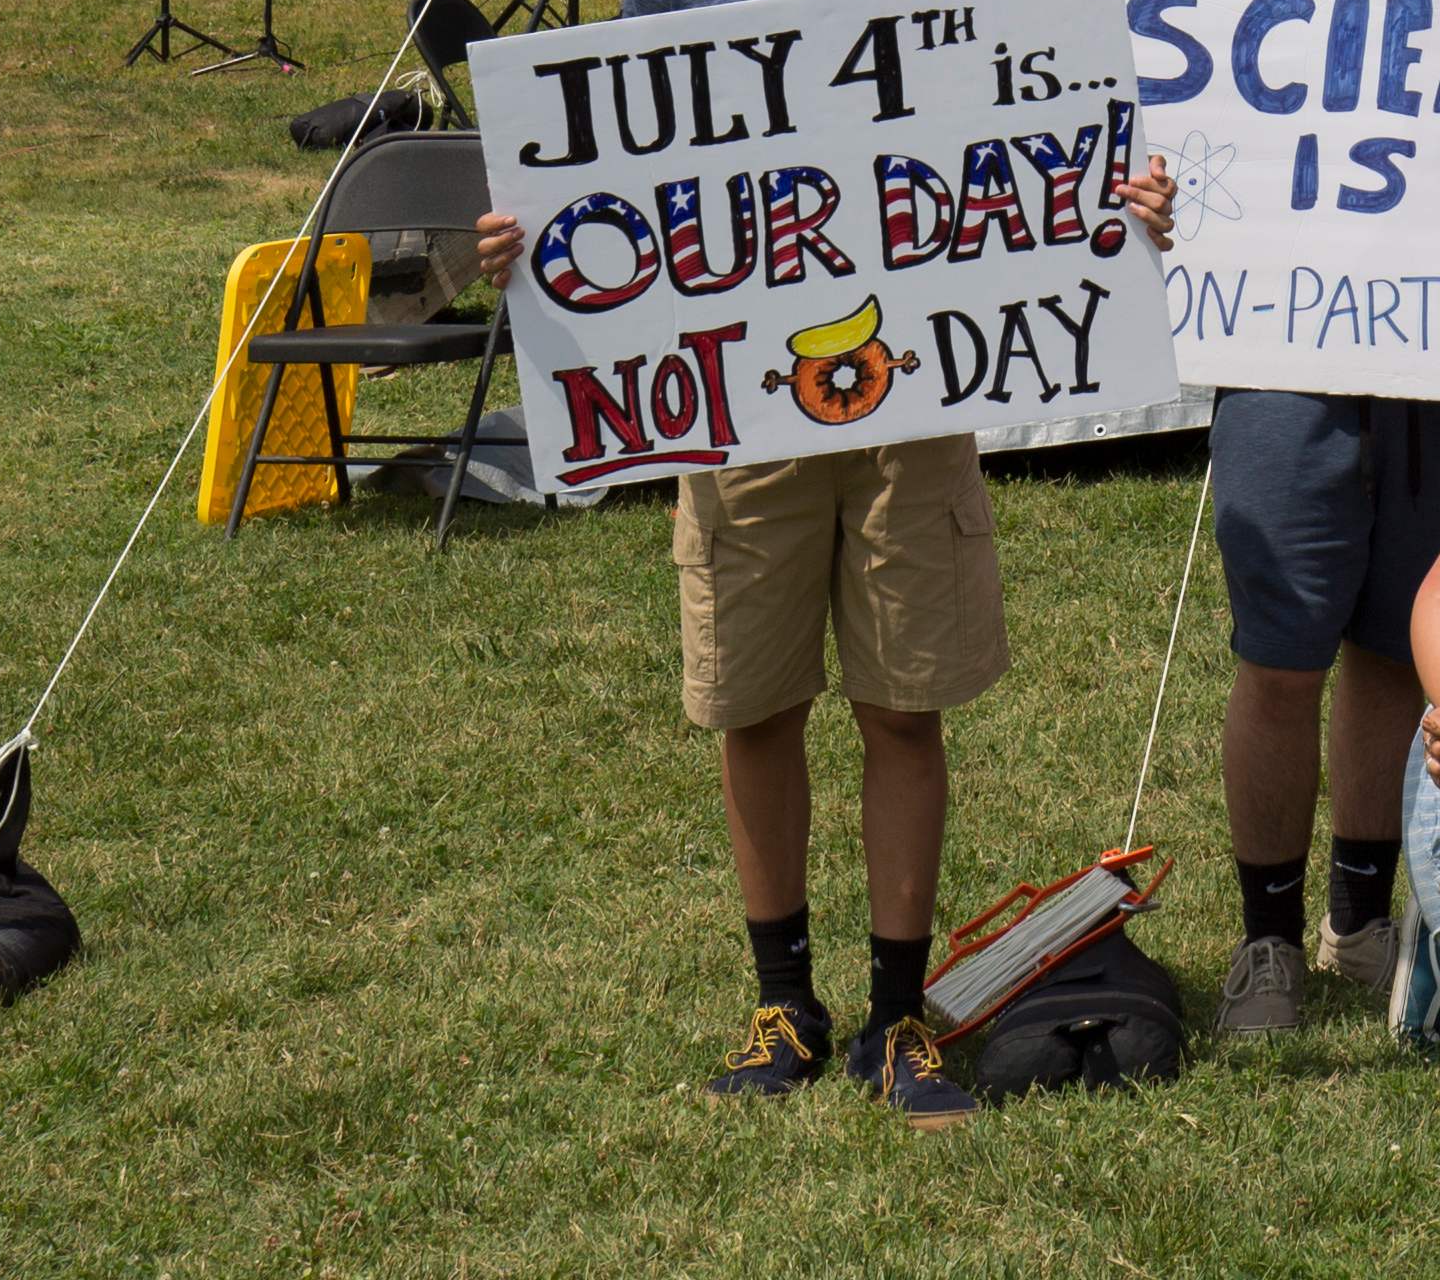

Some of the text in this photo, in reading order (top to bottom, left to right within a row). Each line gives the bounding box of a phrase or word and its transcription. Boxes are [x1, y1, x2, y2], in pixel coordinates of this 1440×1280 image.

[519, 6, 1117, 168] JULY 4TH is...
[1291, 133, 1416, 214] IS
[531, 99, 1135, 314] OUR DAY!
[553, 278, 1110, 464] NOT DAY
